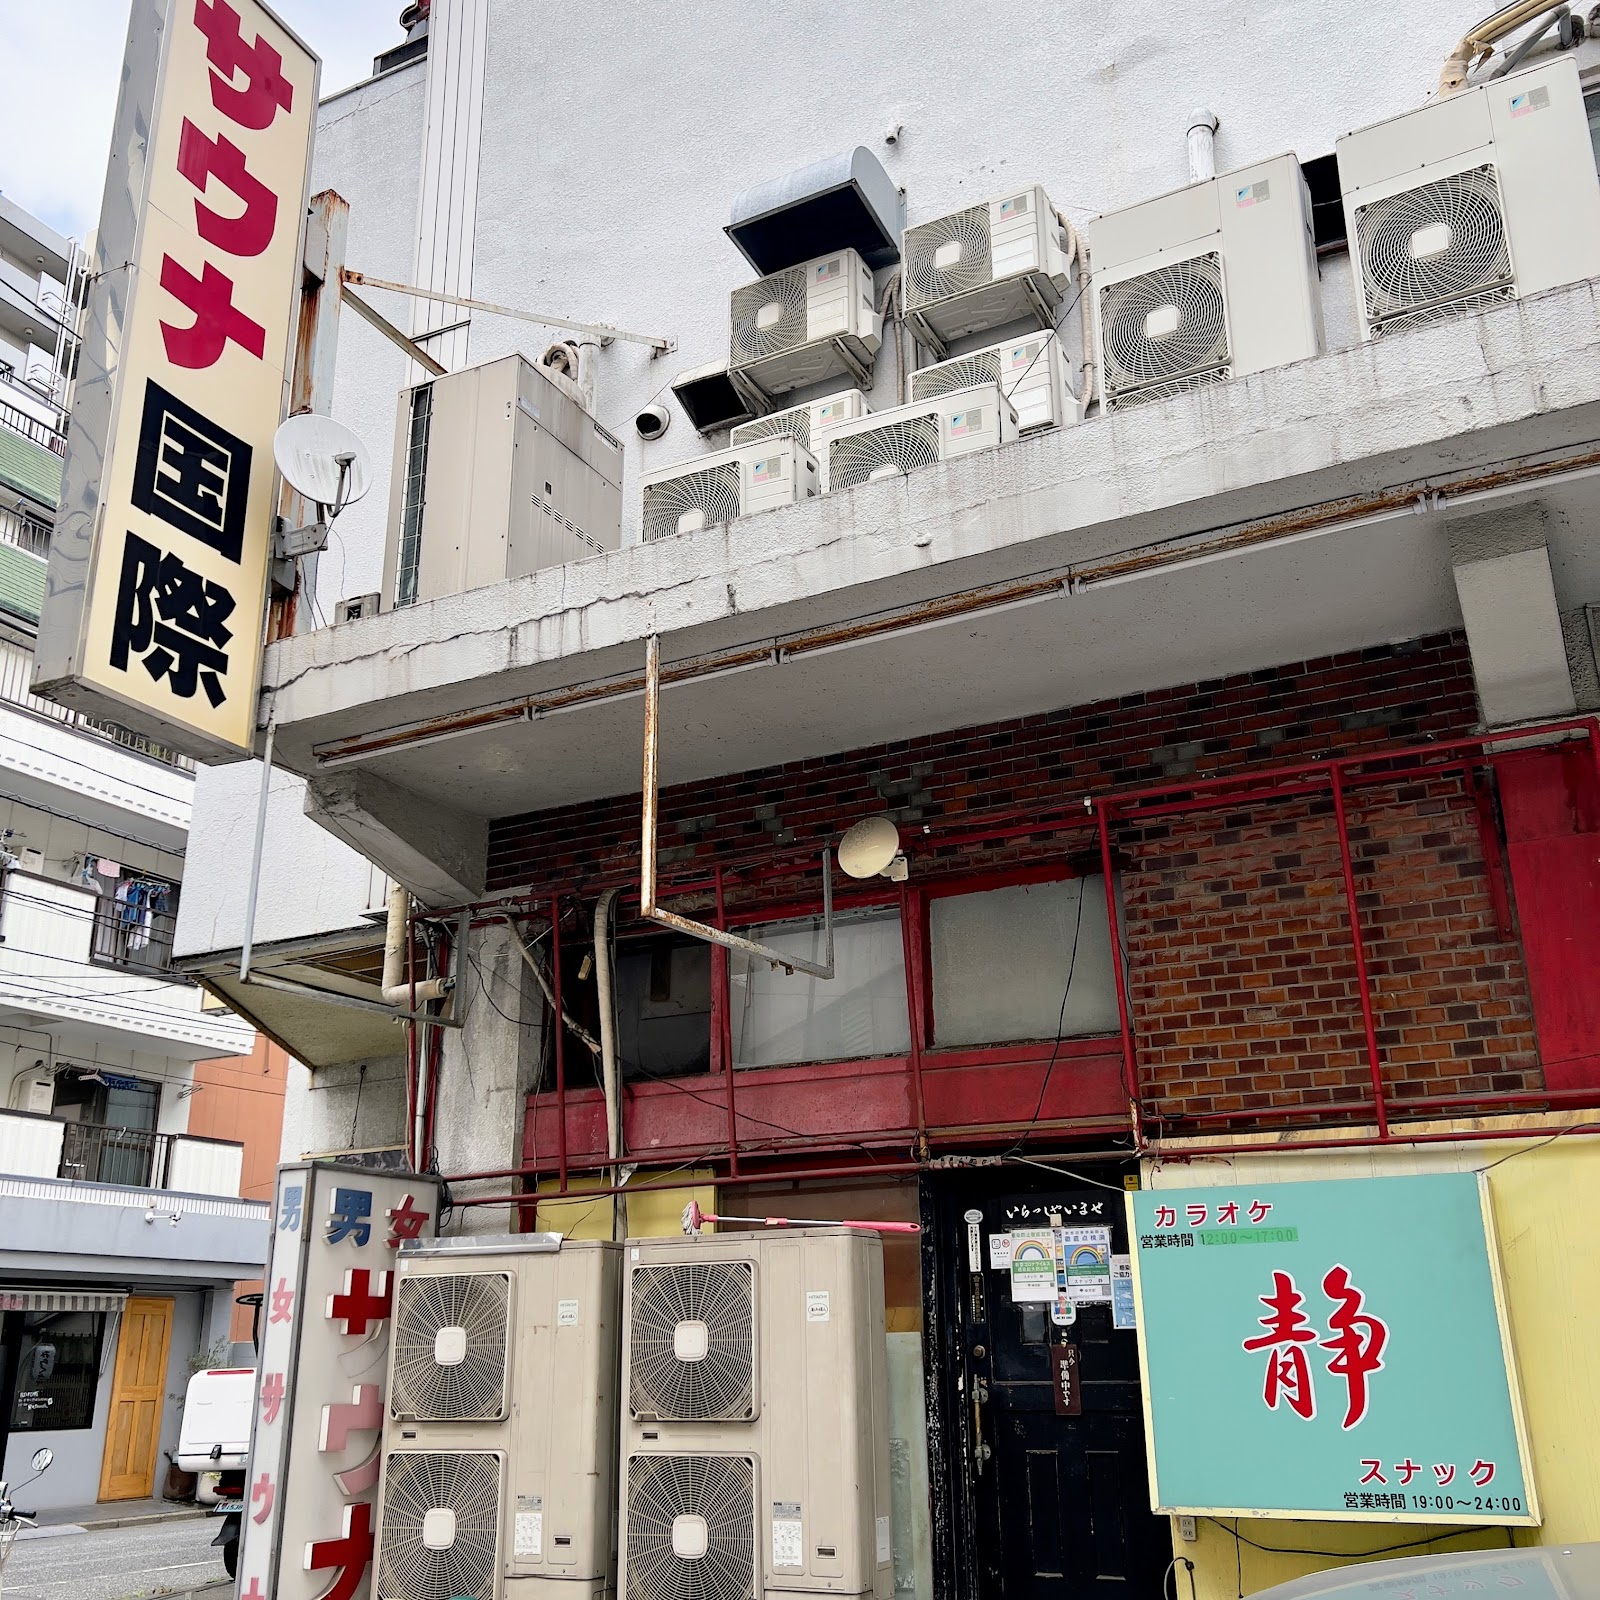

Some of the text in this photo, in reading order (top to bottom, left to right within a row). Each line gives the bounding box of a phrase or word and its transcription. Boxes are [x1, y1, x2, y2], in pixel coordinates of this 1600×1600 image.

[1154, 1199, 1274, 1229] カラオケ
[1140, 1232, 1194, 1249] 営業時間
[1242, 1261, 1391, 1432] 静
[1059, 1359, 1071, 1407] 準備中です
[1359, 1458, 1498, 1488] スナック
[1343, 1492, 1407, 1511] 営業時間
